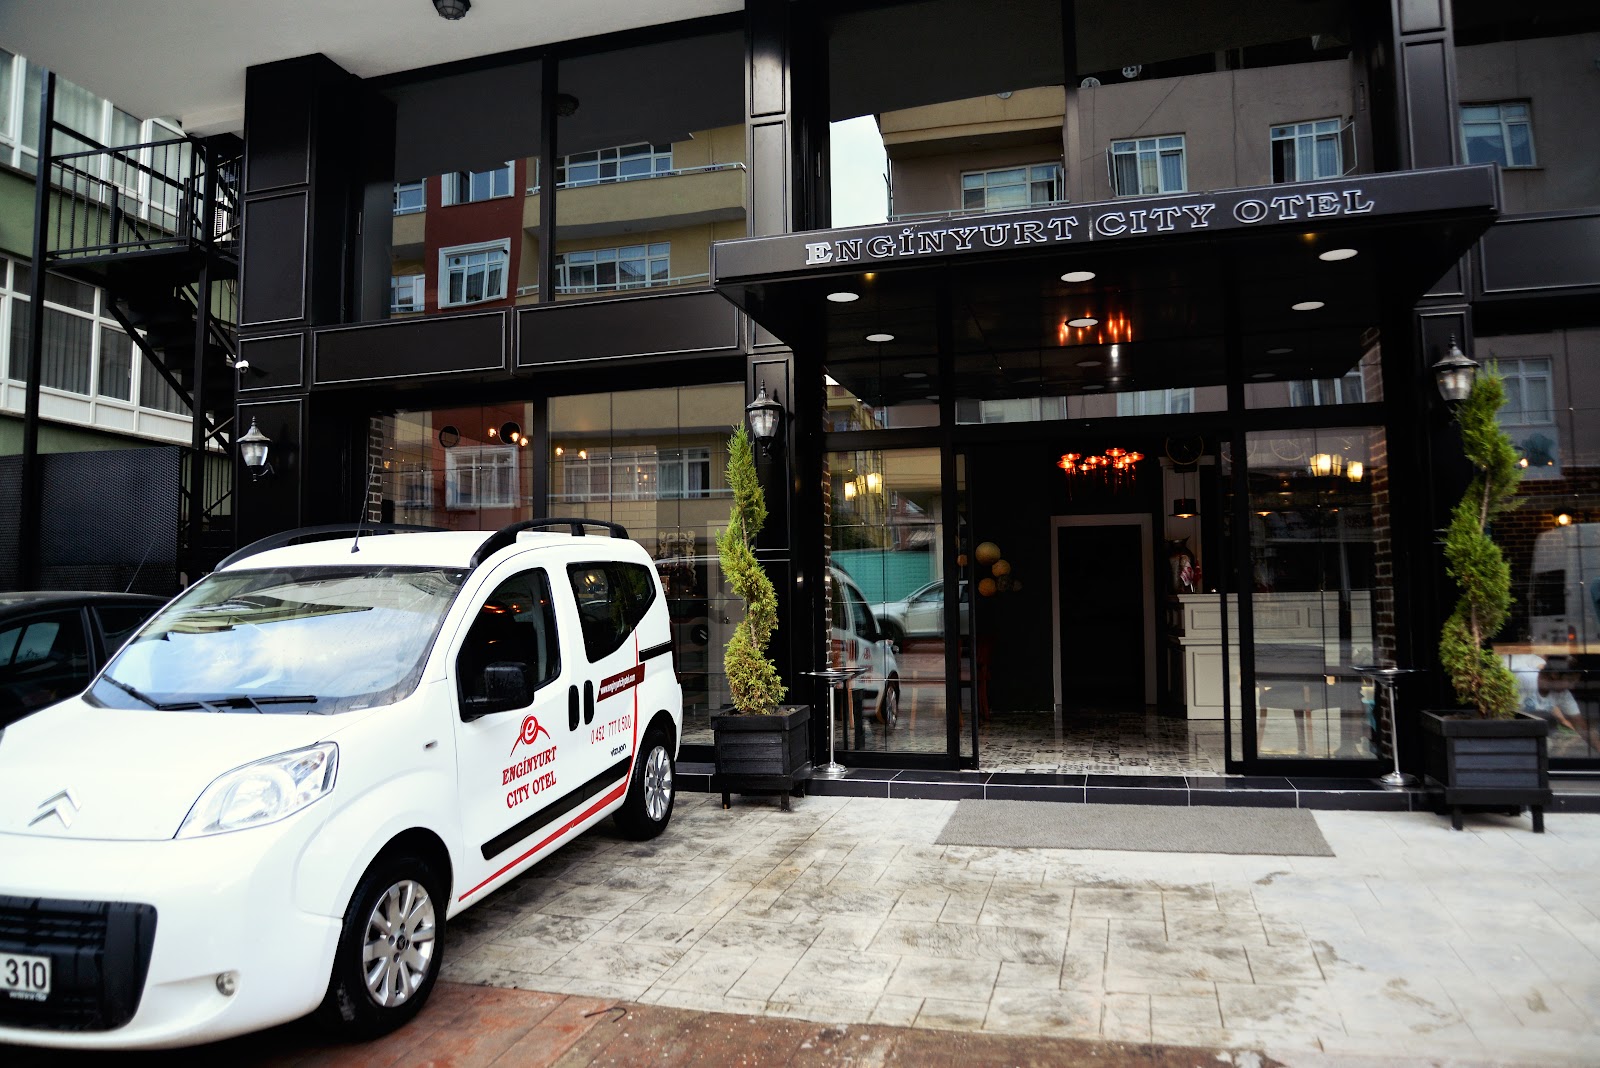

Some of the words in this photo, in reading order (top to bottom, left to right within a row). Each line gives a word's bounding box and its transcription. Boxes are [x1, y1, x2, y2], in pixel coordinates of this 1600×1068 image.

[1095, 203, 1216, 238] CITY
[1233, 188, 1375, 224] OTEL
[506, 783, 530, 809] CITY
[532, 770, 557, 795] OTEL
[5, 958, 47, 990] 310
